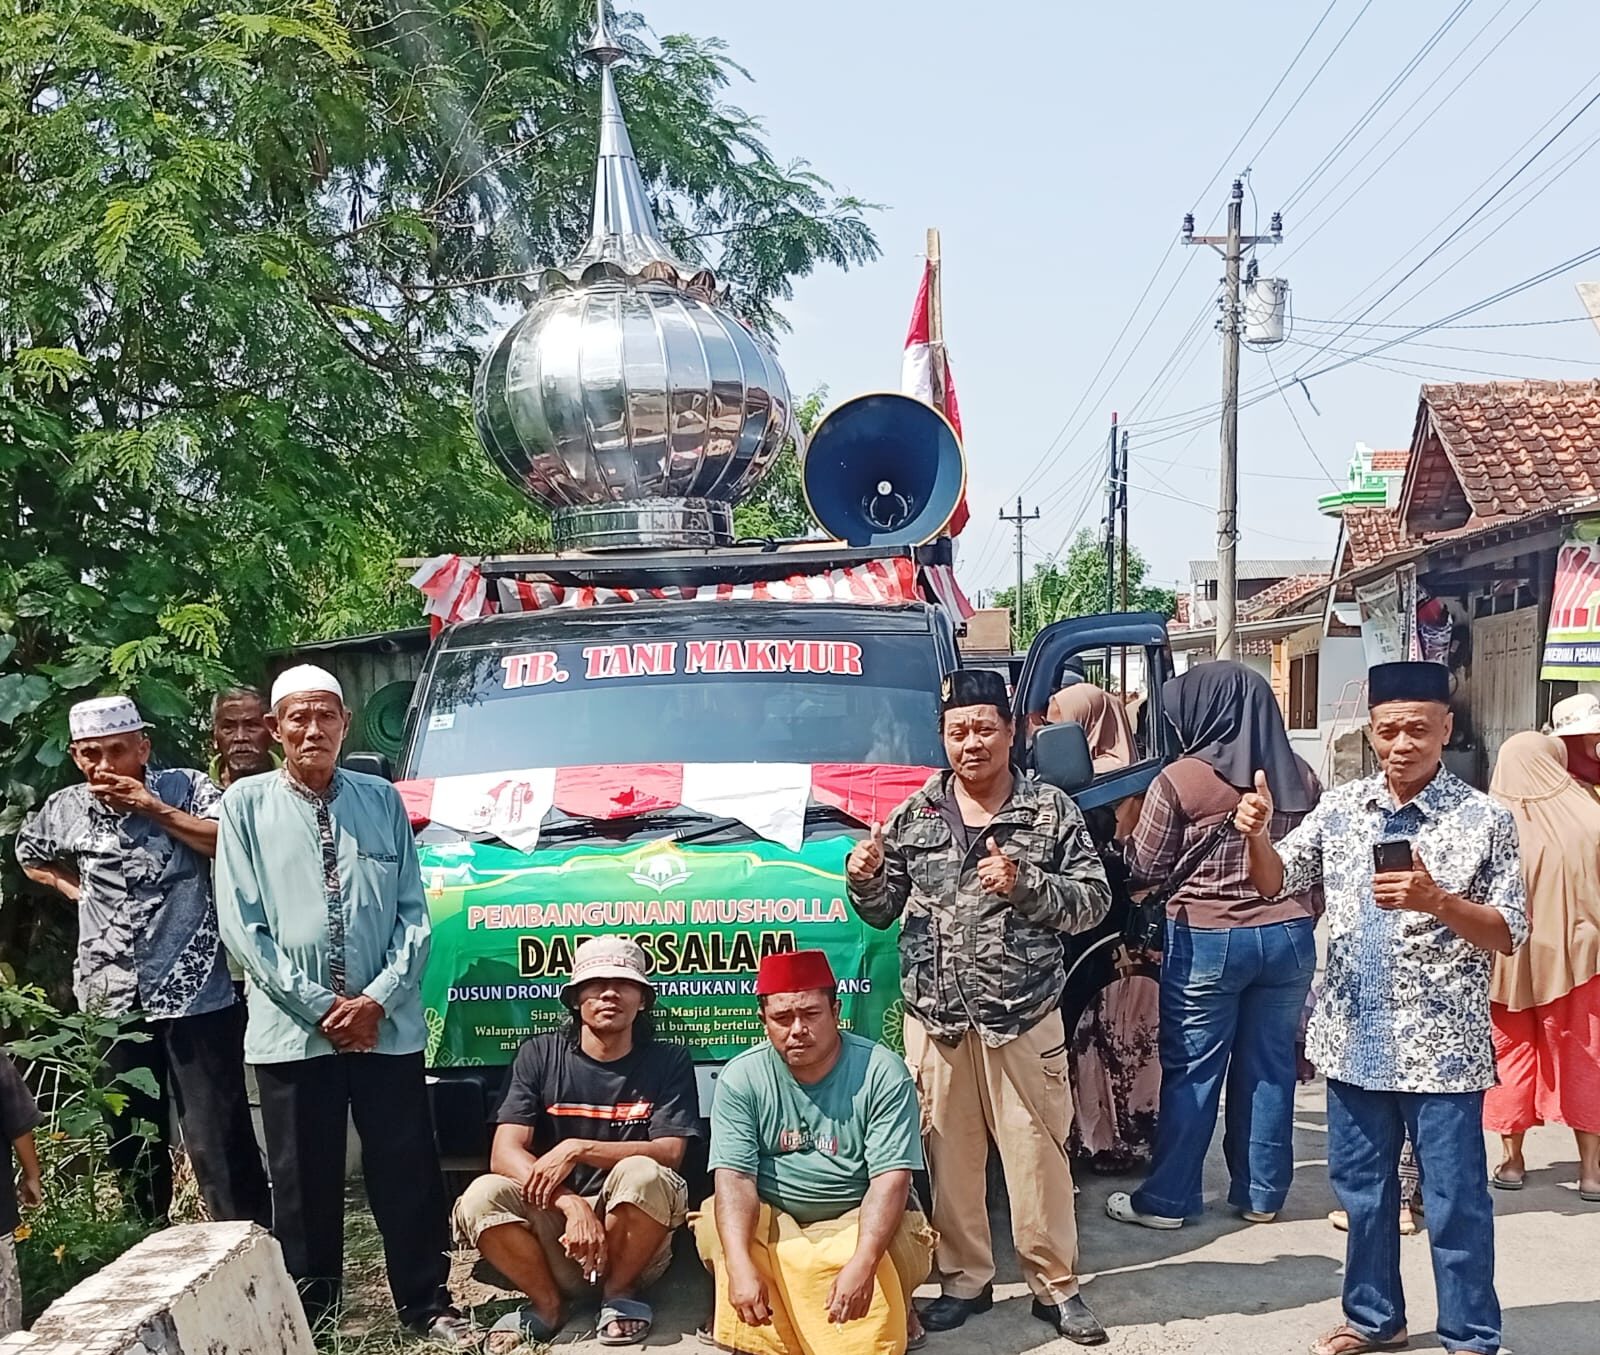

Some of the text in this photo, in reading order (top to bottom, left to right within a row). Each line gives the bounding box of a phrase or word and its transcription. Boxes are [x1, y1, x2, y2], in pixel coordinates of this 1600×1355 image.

[501, 640, 862, 690] TB. TANI MAKMUR
[468, 898, 848, 930] PEMBANGUNAN MUSHOLLA
[518, 930, 797, 978] DASSALAM
[447, 985, 501, 1002] DUSUN
[505, 984, 560, 1000] DRONJ
[671, 1007, 710, 1020] Masjid
[714, 1006, 752, 1017] karena
[475, 1025, 530, 1039] Walaupun
[669, 1021, 711, 1034] burung
[713, 1020, 761, 1031] bertelur
[688, 1034, 727, 1048] seperti
[731, 1034, 747, 1045] itu
